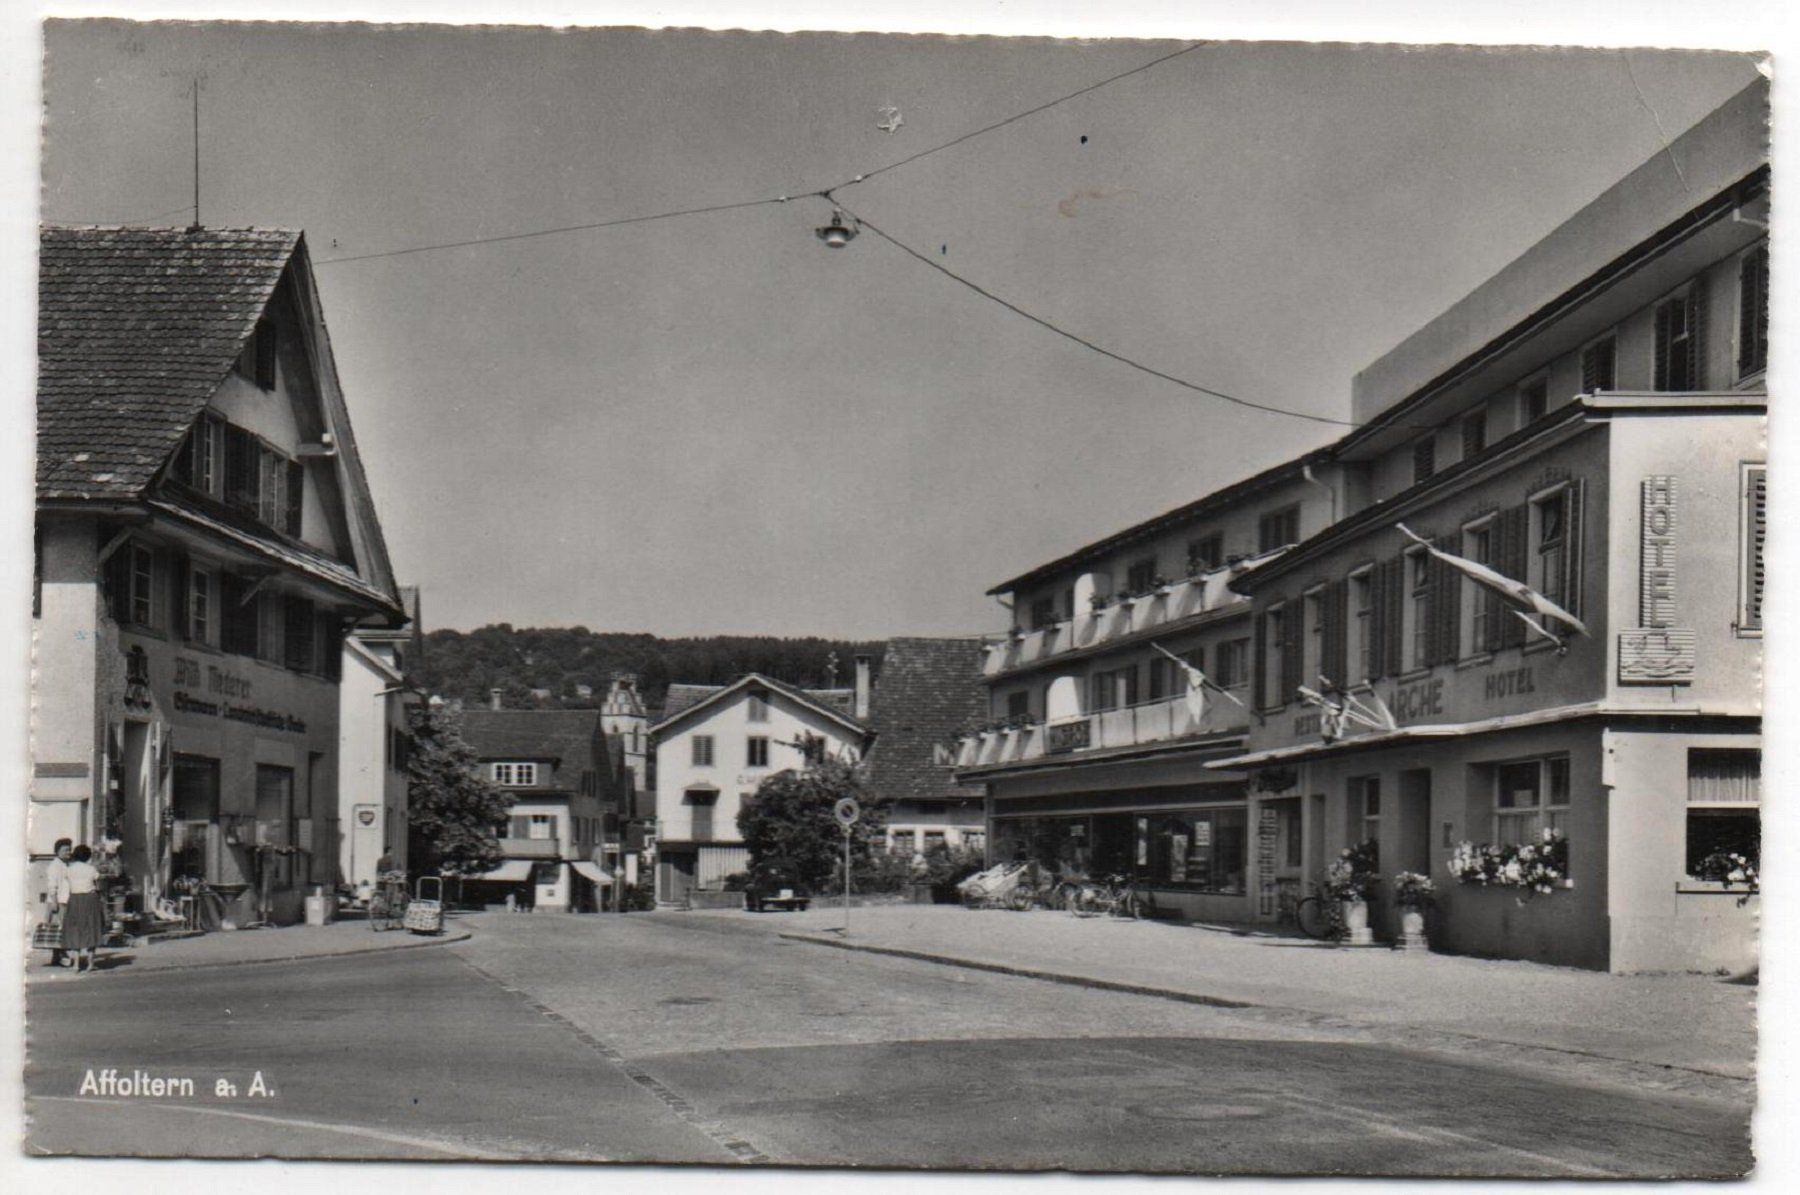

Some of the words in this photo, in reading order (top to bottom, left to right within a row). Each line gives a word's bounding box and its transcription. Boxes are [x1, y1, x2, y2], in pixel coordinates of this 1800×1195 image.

[1651, 475, 1671, 628] HOTEL
[1389, 679, 1444, 721] ARCHE
[1486, 667, 1535, 701] HOTEL
